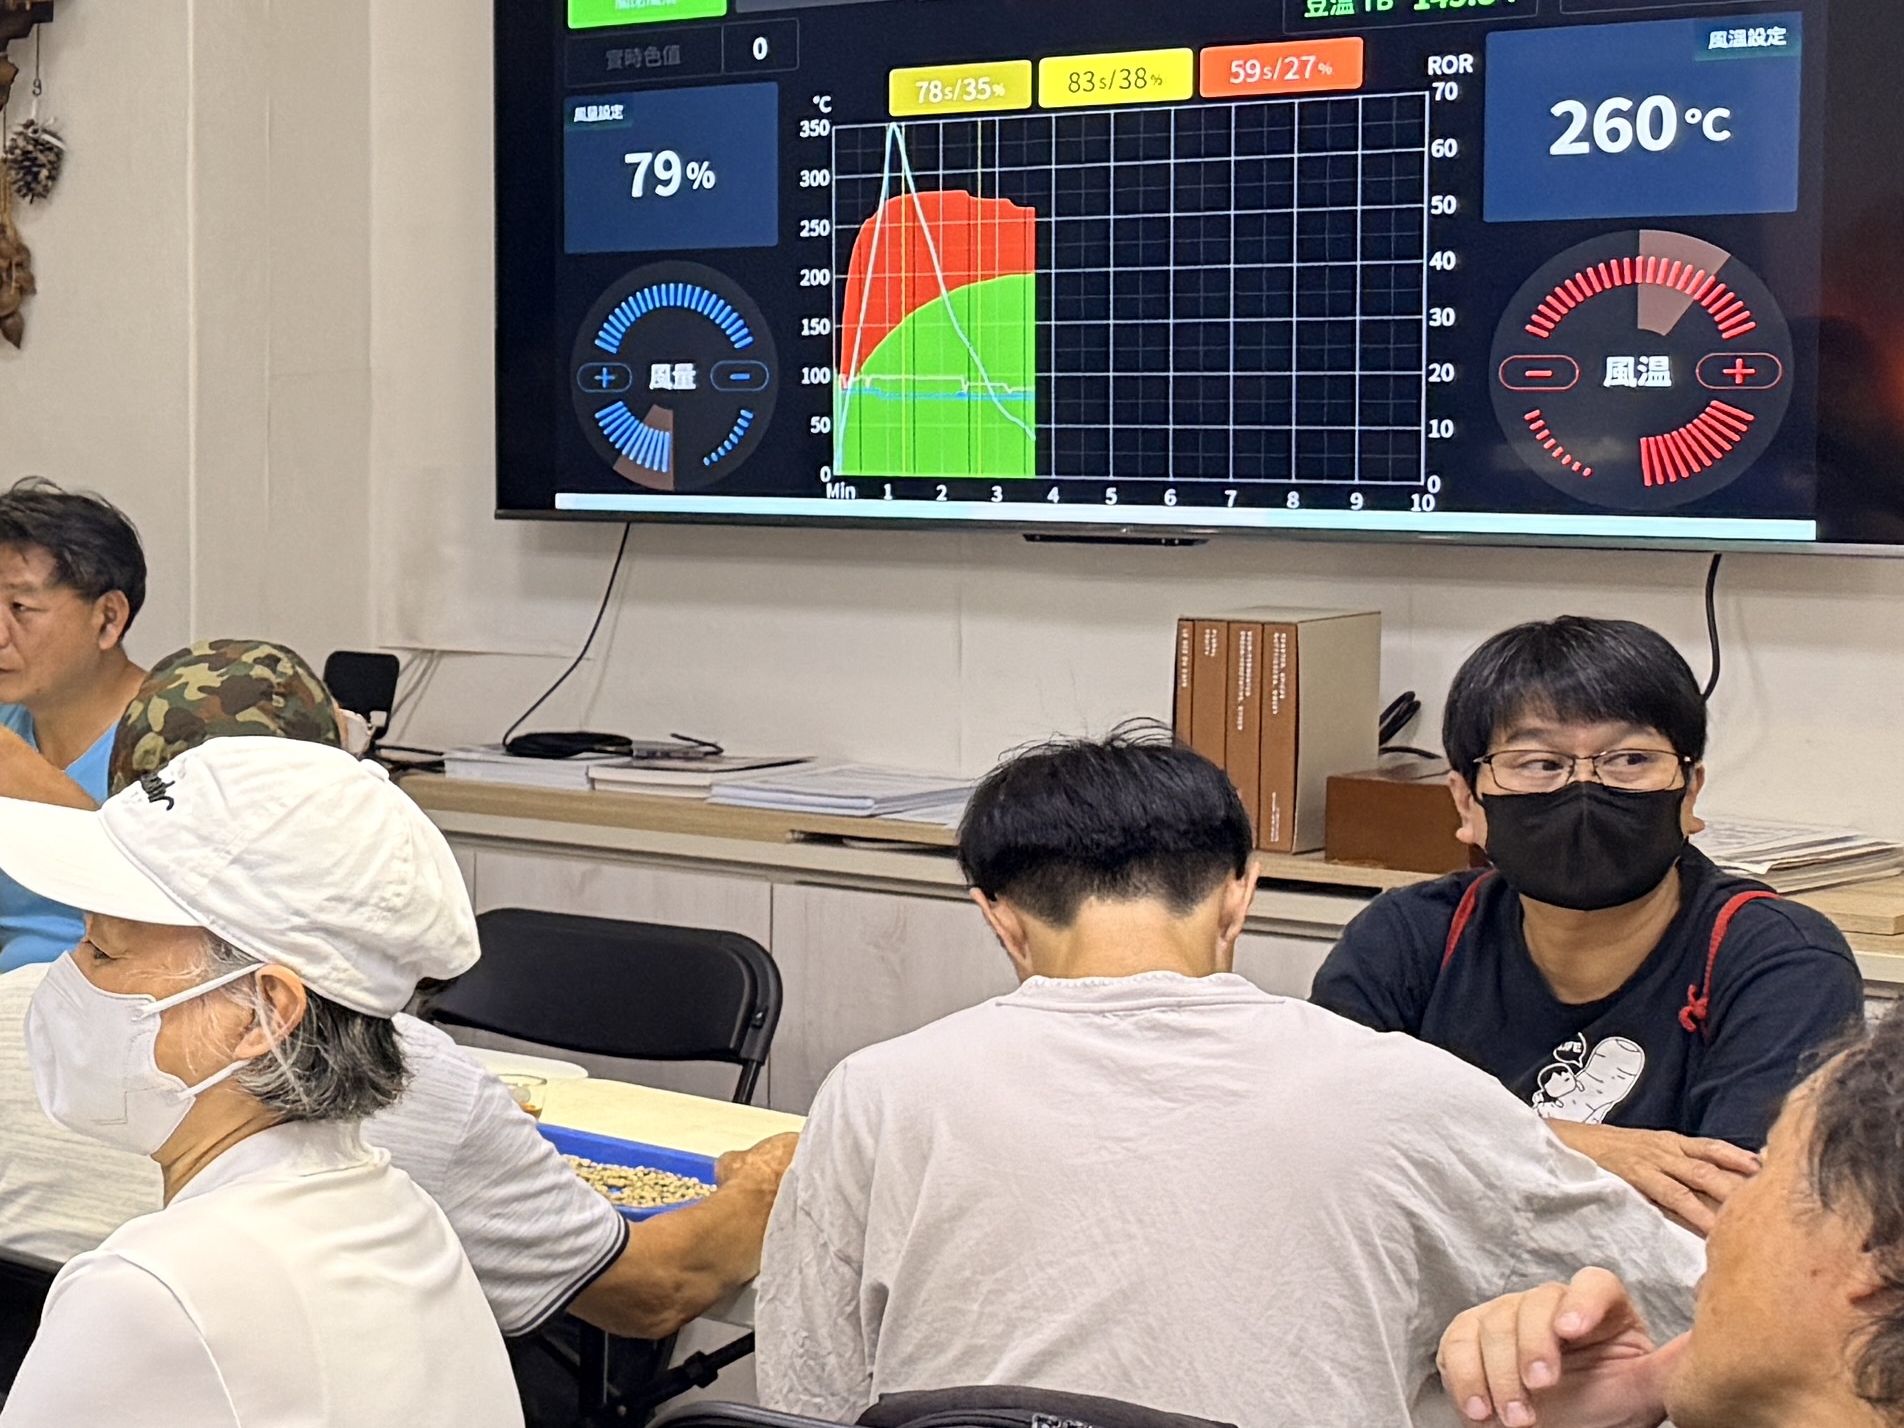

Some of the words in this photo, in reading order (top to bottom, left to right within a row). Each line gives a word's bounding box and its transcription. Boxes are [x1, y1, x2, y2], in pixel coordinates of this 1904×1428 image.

[752, 36, 769, 61] 0
[1427, 53, 1475, 76] ROR
[1431, 82, 1459, 102] 70
[799, 119, 831, 138] 350
[1431, 138, 1458, 159] 60
[623, 149, 717, 199] 79%
[799, 169, 831, 188] 300
[1431, 195, 1457, 215] 50
[799, 219, 831, 238] 250
[1430, 251, 1457, 271] 40
[799, 268, 831, 287] 200
[800, 318, 831, 336] 150
[1429, 307, 1456, 328] 30
[800, 367, 831, 385] 100
[1429, 364, 1456, 383] 20
[810, 416, 831, 435] 50
[1429, 419, 1455, 439] 10
[819, 465, 832, 483] 0
[1427, 474, 1442, 494] 0
[825, 479, 857, 503] Min
[882, 483, 894, 503] 1
[935, 483, 949, 503] 2
[990, 484, 1004, 504] 3
[1047, 486, 1061, 506] 4
[1104, 487, 1119, 506] 5
[1163, 488, 1177, 507] 6
[1224, 489, 1239, 509] 7
[1286, 490, 1301, 510] 8
[1349, 490, 1364, 511] 9
[1410, 491, 1436, 514] 10
